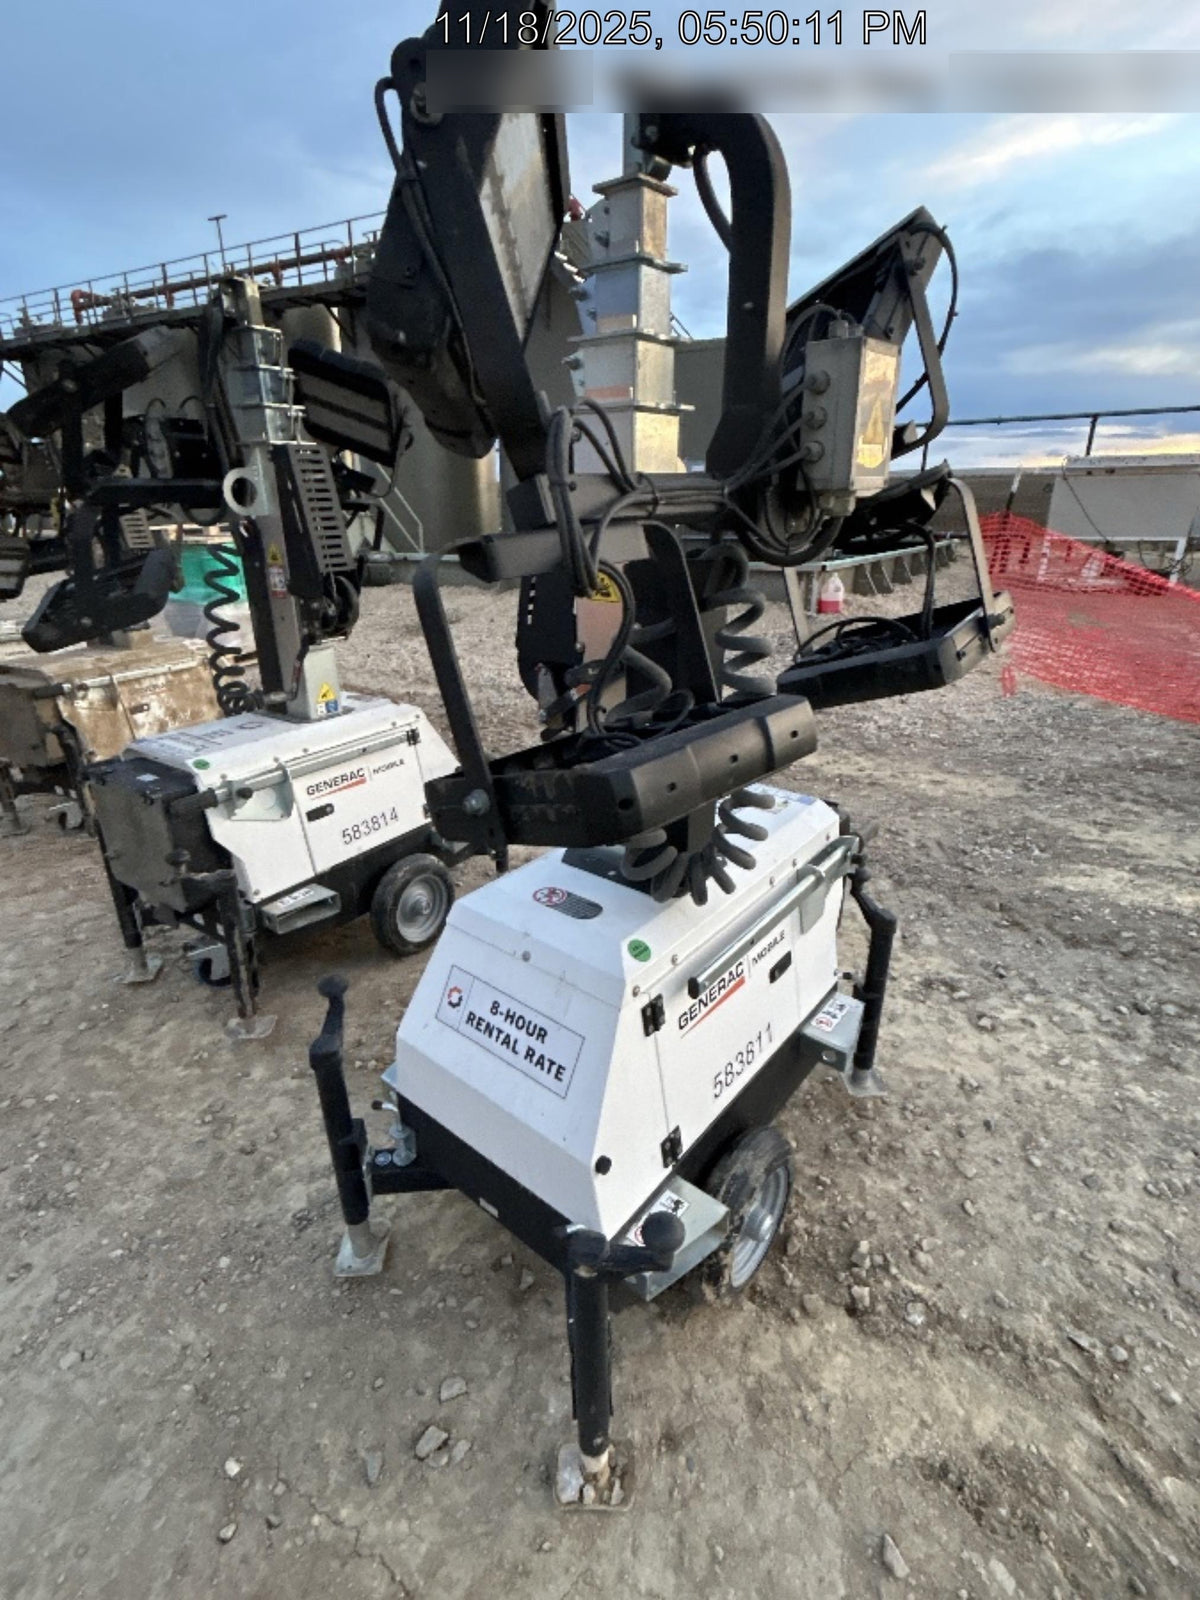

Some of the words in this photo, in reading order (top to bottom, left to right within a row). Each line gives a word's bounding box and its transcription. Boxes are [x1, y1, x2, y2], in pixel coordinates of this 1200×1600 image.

[306, 768, 366, 796] GENERAC
[342, 806, 399, 845] 583814
[678, 961, 744, 1030] GENERAC
[752, 929, 785, 966] MOBILE
[490, 1000, 548, 1044] 8-HOUR
[465, 1011, 519, 1055] RENTAL
[524, 1045, 566, 1082] RATE
